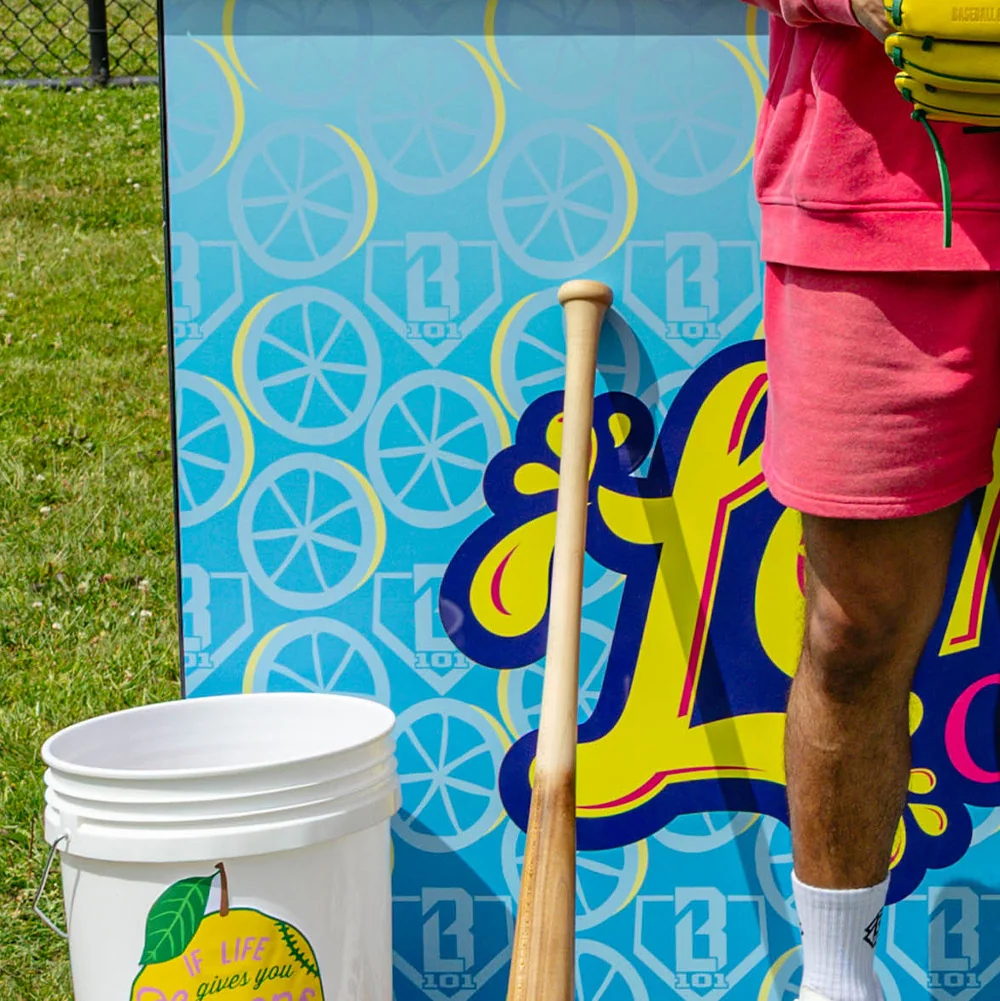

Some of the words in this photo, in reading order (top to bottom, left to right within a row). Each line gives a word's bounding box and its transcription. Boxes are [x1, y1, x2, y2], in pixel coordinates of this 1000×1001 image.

[173, 323, 203, 338] 01
[406, 322, 462, 339] 101
[665, 321, 721, 339] 101
[184, 651, 213, 669] 01
[414, 651, 471, 669] 101
[183, 948, 204, 977] IF
[220, 936, 270, 965] LIFE
[196, 972, 251, 1001] gives
[252, 964, 294, 990] you
[422, 972, 477, 990] 101
[674, 972, 729, 990] 101
[927, 971, 981, 988] 101
